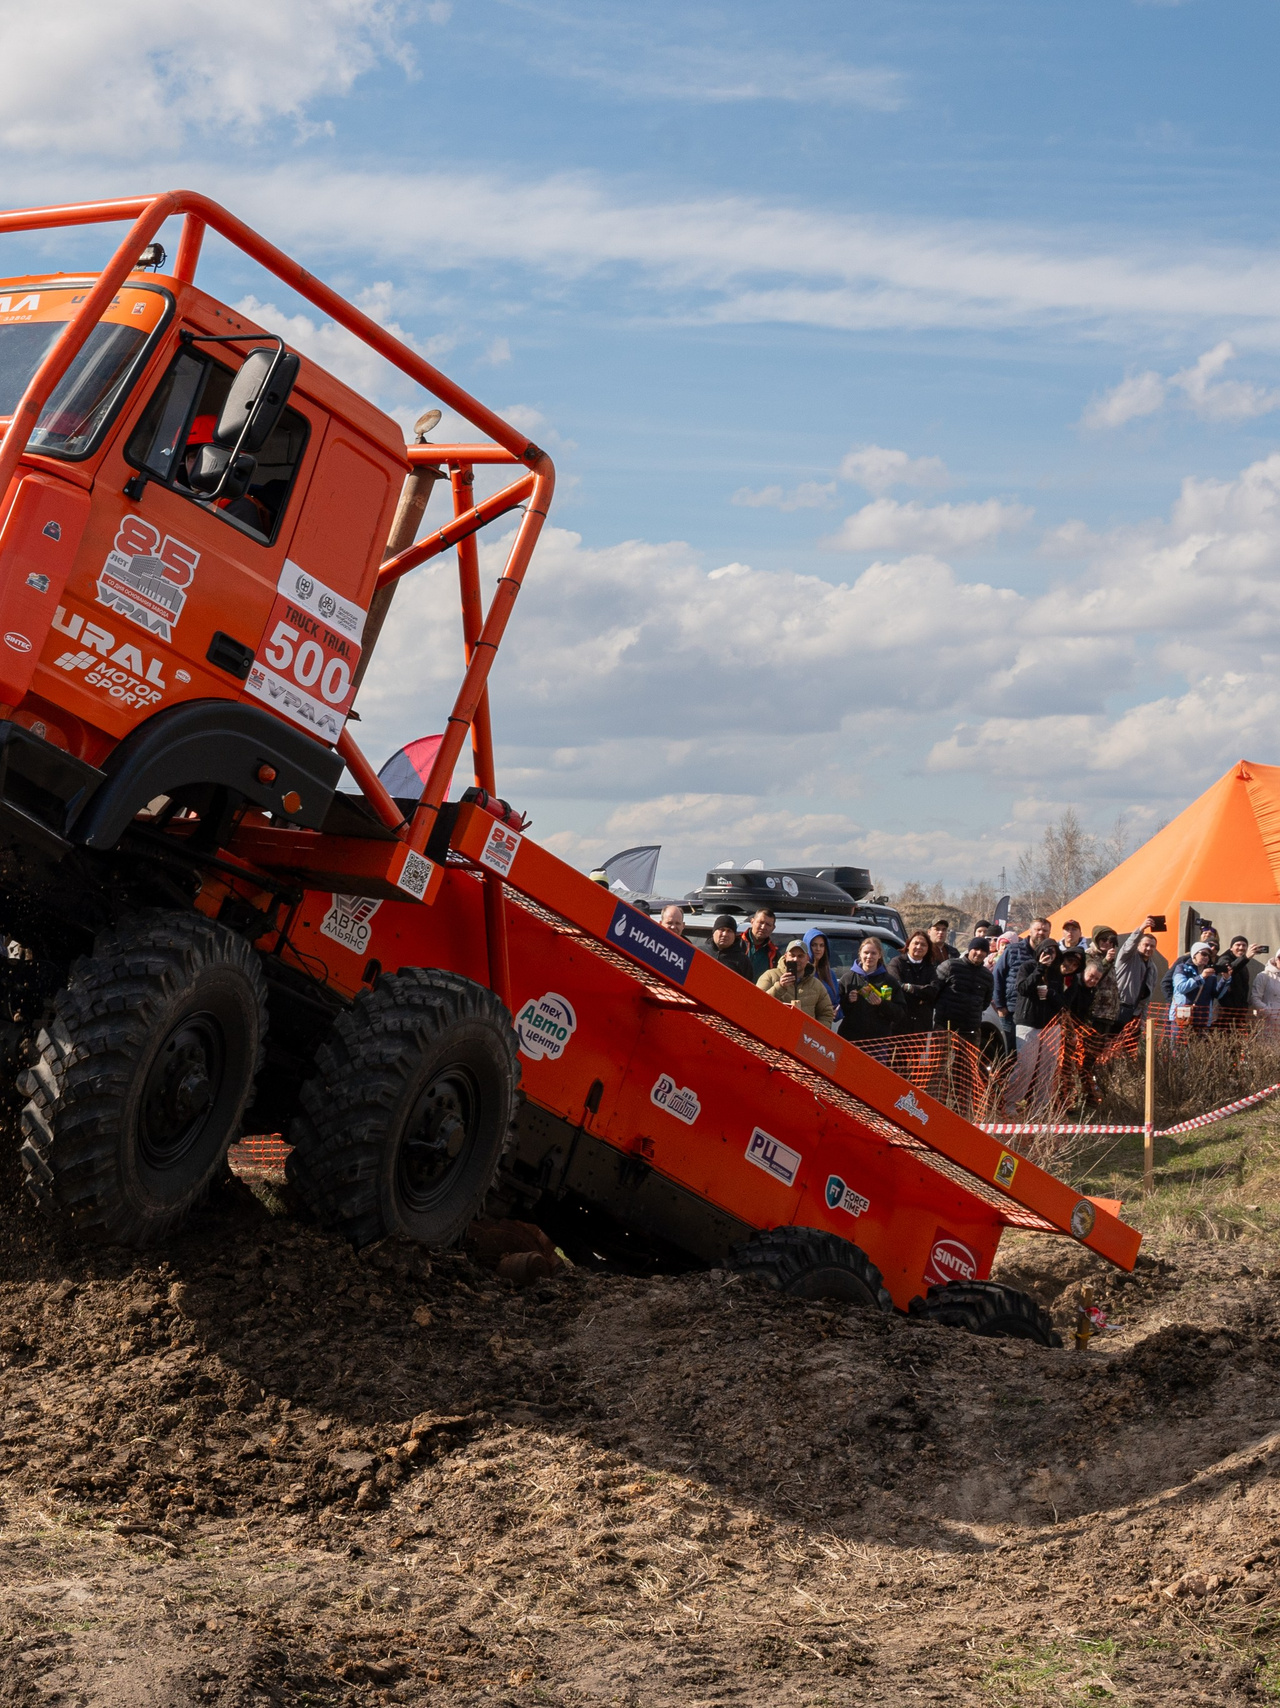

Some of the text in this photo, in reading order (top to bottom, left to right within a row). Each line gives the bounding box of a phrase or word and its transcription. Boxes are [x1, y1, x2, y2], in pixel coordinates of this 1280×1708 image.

[3, 314, 33, 322] завод
[110, 553, 129, 568] лет
[114, 514, 201, 589] 85
[97, 584, 170, 640] УРАЛ
[6, 634, 30, 650] SINTEC
[286, 605, 320, 638] TRUCK
[322, 629, 351, 660] TRIAL
[51, 605, 166, 690] URAL
[265, 620, 351, 704] 500
[94, 662, 163, 704] MOTOR
[251, 668, 266, 681] 85
[84, 671, 150, 709] SPORT
[267, 678, 340, 736] УРАЛ
[492, 828, 517, 851] 85
[485, 854, 507, 871] УРАЛ
[323, 922, 366, 951] АЛЬЯНС
[327, 909, 368, 940] АВТО
[629, 926, 685, 971] НИАГАРА
[520, 1005, 568, 1041] Авто
[539, 1000, 563, 1020] тех
[525, 1029, 561, 1054] центр
[803, 1033, 836, 1062] УРАЛ
[829, 1184, 841, 1198] FT
[845, 1190, 869, 1210] FORCE
[843, 1198, 861, 1215] TIME
[933, 1247, 975, 1281] SINTEC
